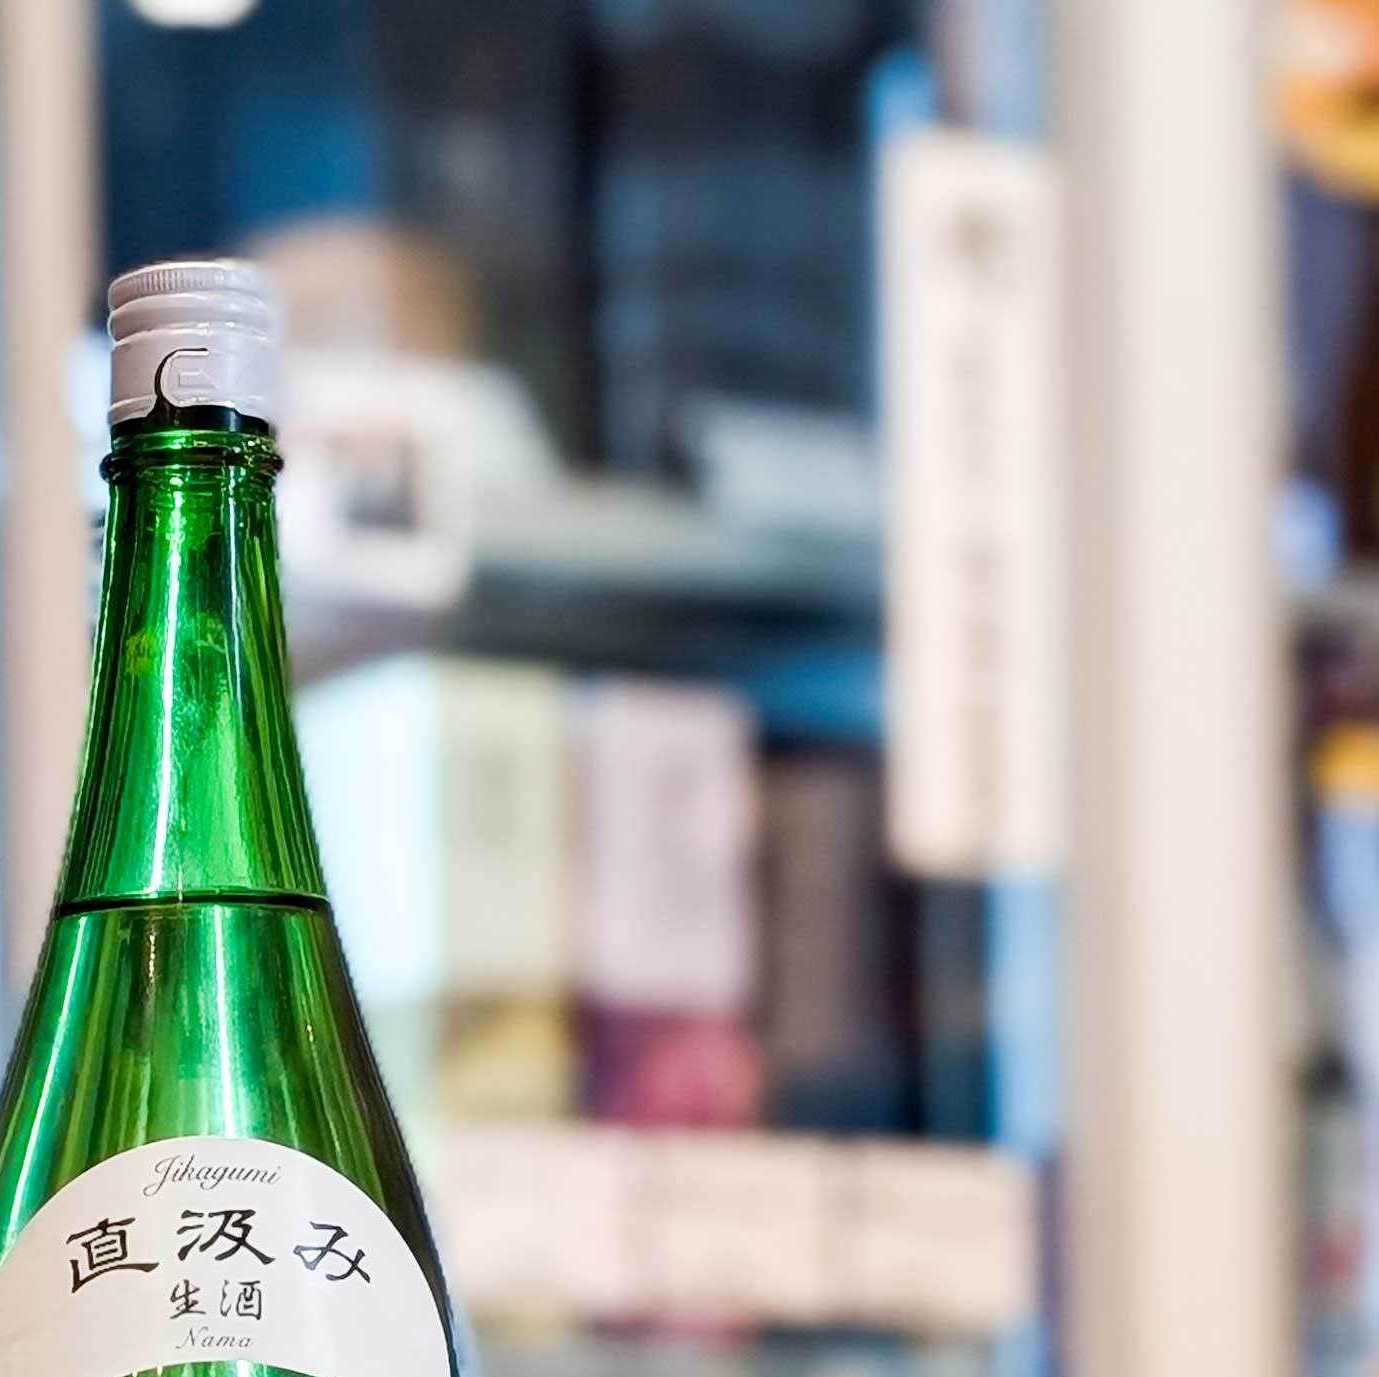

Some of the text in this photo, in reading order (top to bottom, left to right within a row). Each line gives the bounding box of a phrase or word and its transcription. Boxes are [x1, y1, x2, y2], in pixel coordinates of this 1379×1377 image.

[142, 1153, 283, 1197] Jikagumi
[65, 1208, 372, 1294] 直汲み
[169, 1278, 264, 1321] 生酒
[175, 1325, 254, 1350] Nama
